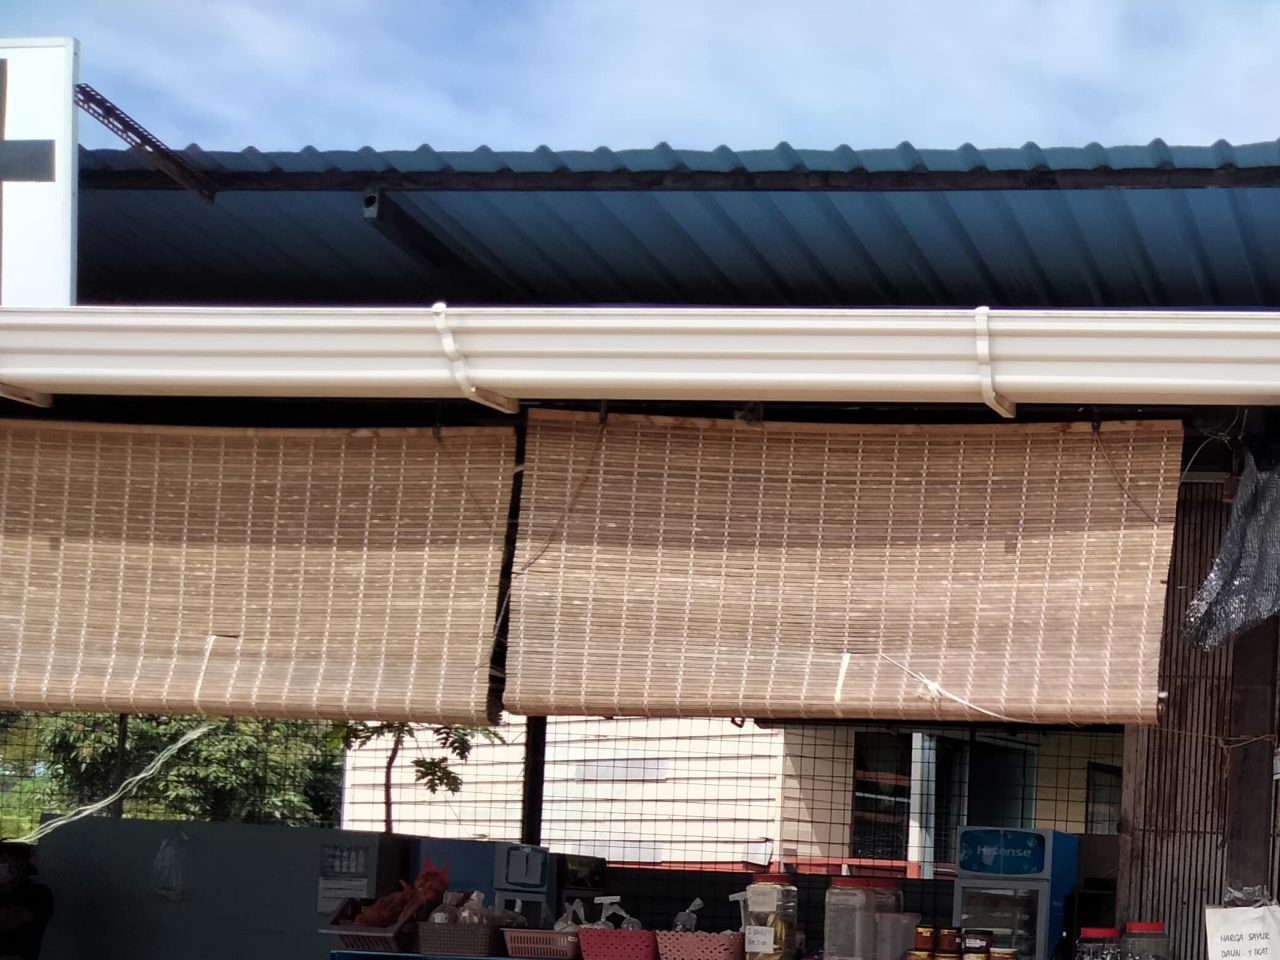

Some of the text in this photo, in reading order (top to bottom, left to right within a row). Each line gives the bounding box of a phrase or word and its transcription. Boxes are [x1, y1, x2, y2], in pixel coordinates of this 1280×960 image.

[976, 845, 1032, 857] Hisense
[1220, 932, 1270, 943] HARGA SAYUR
[1221, 949, 1241, 958] DAUN
[1254, 947, 1269, 956] IKAT
